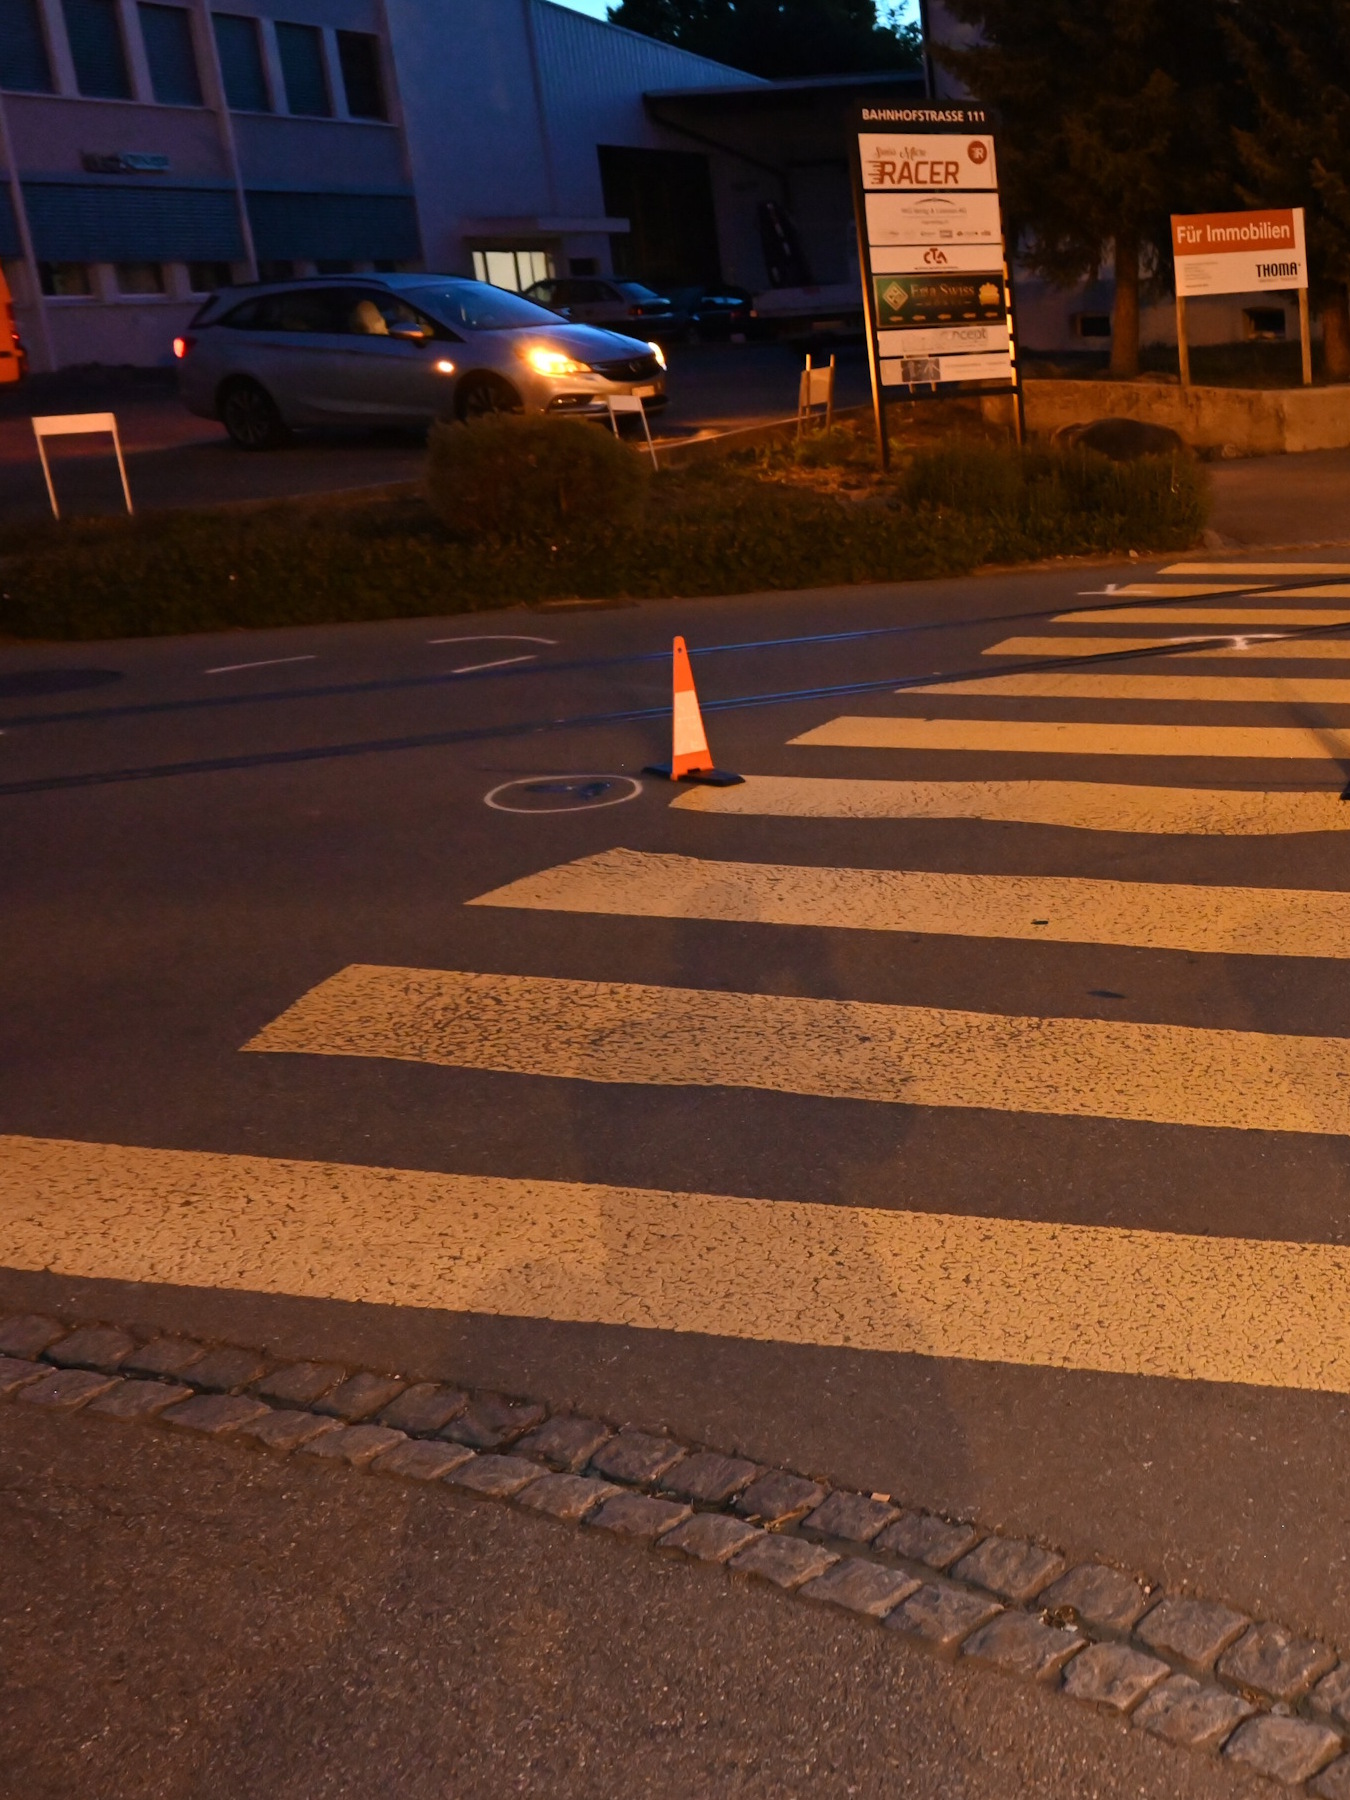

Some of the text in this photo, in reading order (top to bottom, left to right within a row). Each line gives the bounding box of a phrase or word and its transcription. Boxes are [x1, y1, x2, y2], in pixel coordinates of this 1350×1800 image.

[861, 108, 985, 122] BAHNHOFSTRASSE 111
[877, 160, 960, 185] RACER
[1176, 222, 1291, 244] Für Immobilien
[1255, 262, 1299, 278] THOMA
